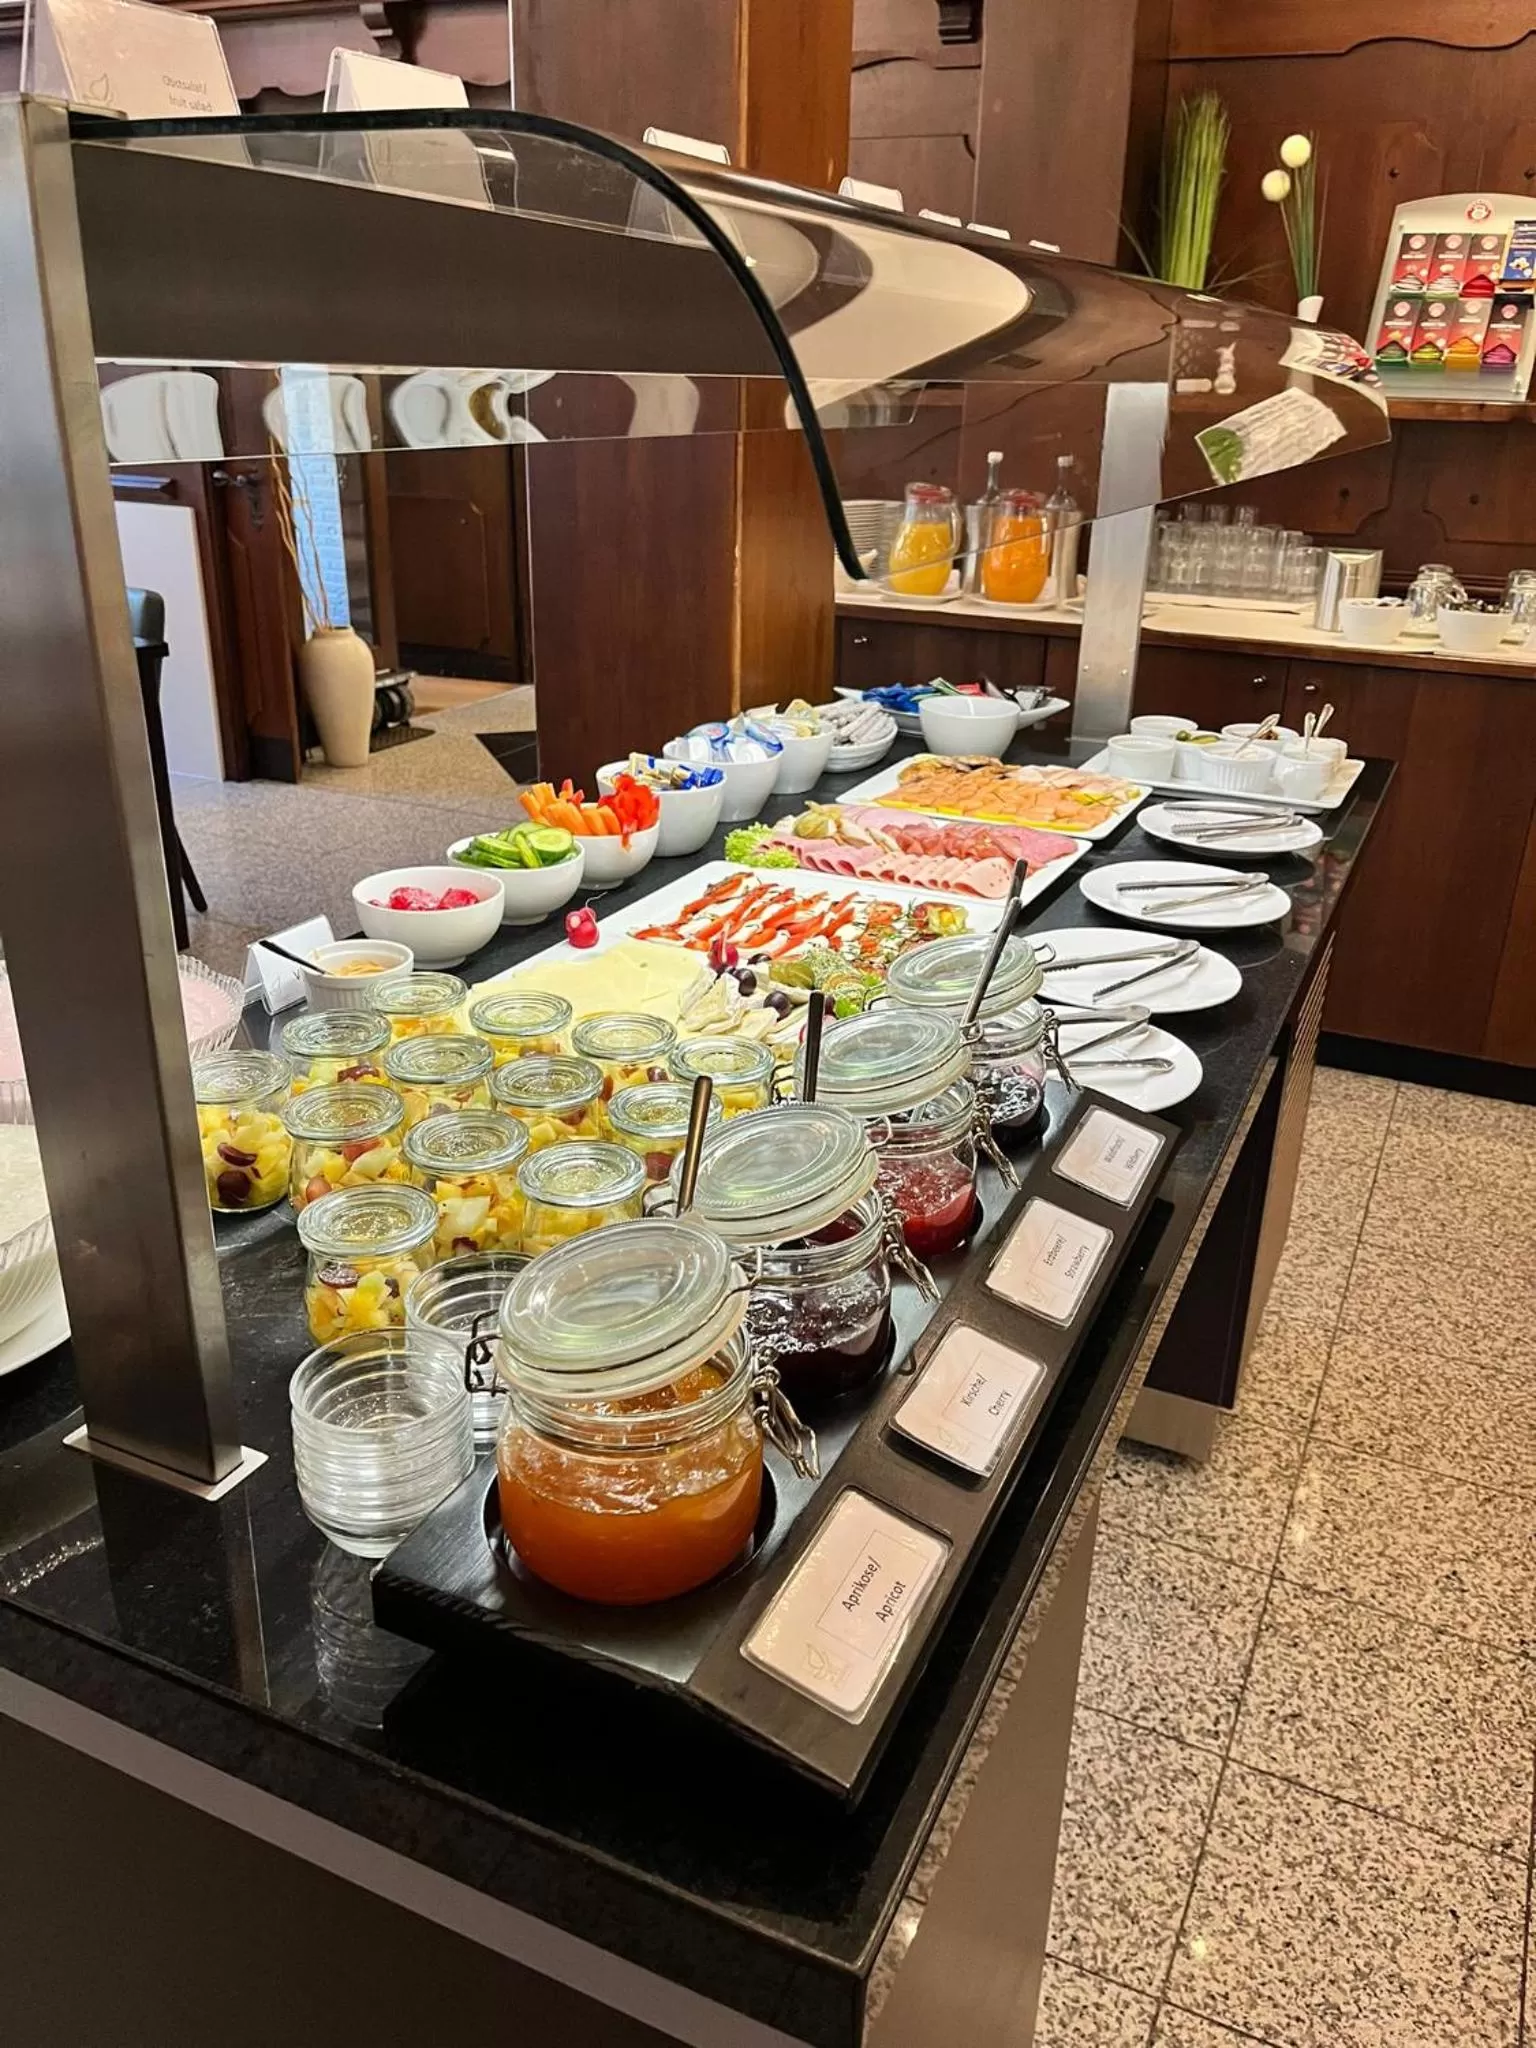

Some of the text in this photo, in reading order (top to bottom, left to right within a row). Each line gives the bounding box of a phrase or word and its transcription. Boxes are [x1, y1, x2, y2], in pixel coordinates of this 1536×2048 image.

[960, 1372, 988, 1408] Kirsche/
[988, 1389, 1012, 1417] Cherry
[841, 1555, 882, 1613] Aprikose/
[875, 1581, 906, 1623] Apricot
